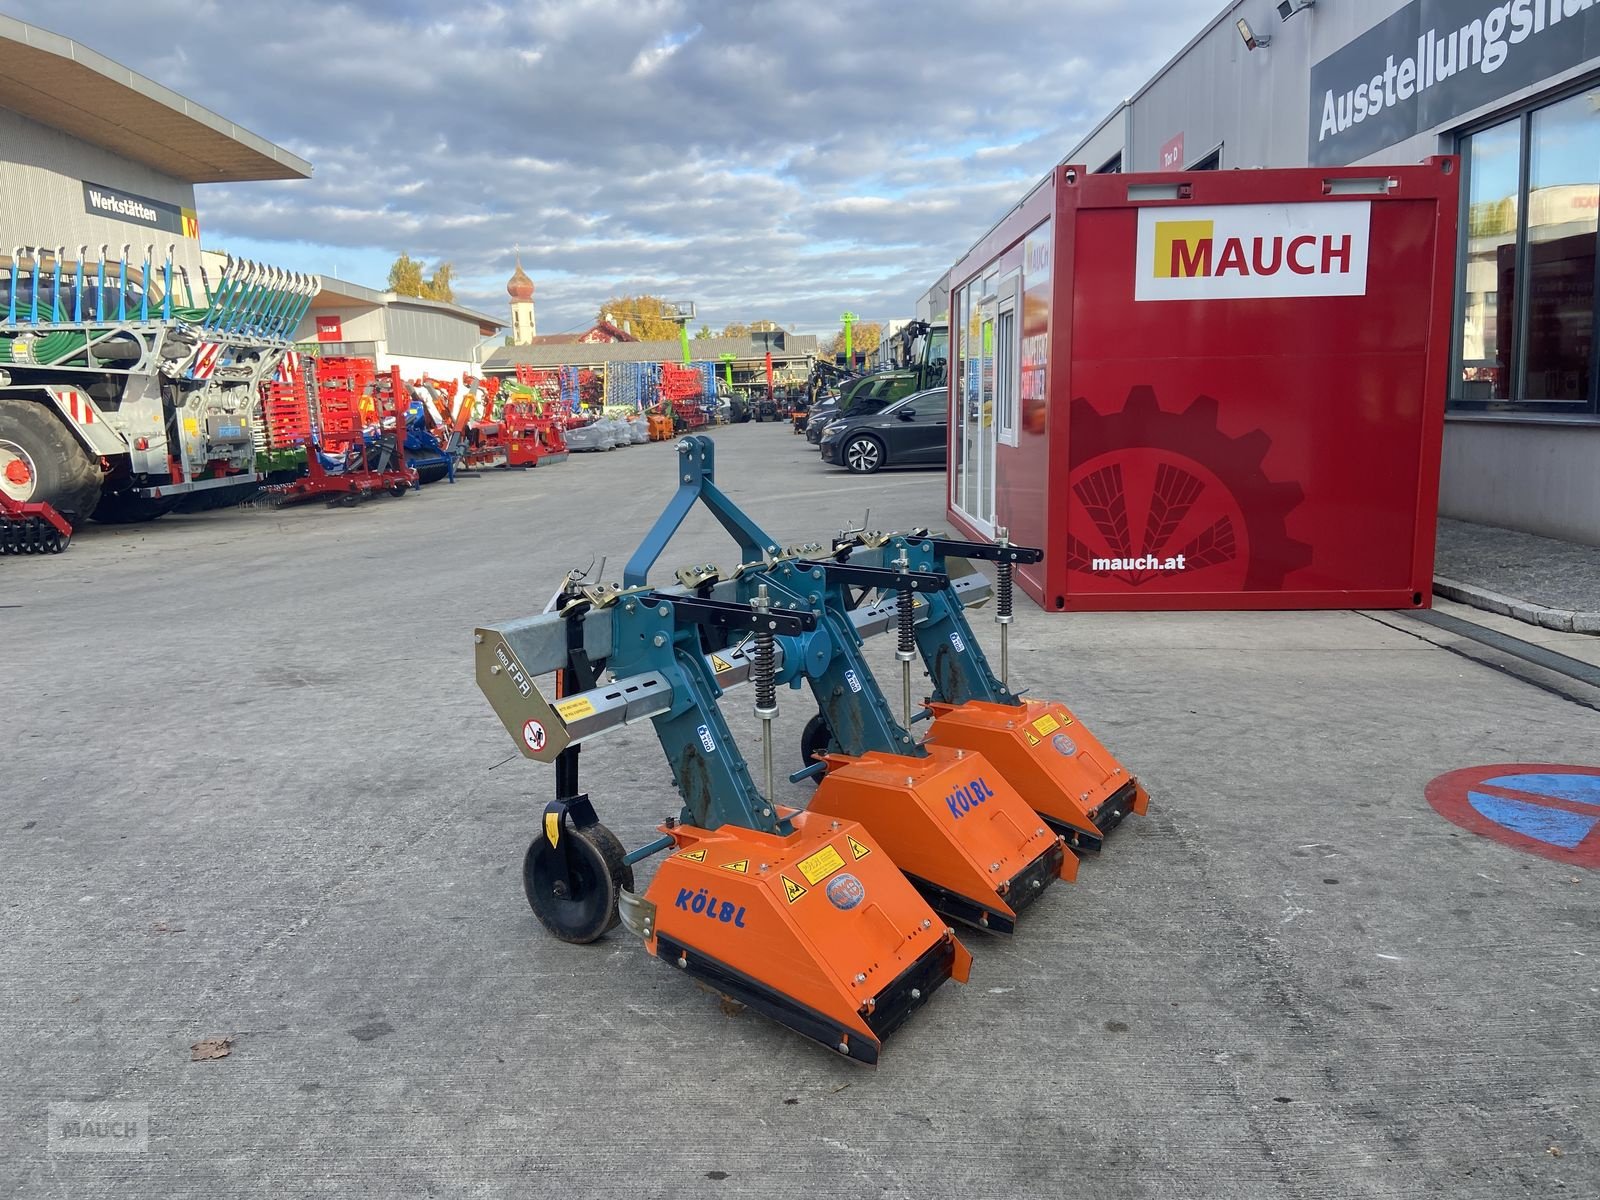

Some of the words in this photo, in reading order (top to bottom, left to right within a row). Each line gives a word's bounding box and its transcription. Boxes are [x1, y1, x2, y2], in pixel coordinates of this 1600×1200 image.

[89, 190, 157, 221] Werkstätten
[1170, 235, 1352, 278] MAUCH
[1092, 554, 1186, 570] mauch.at
[945, 777, 994, 820] KÖLBL
[675, 887, 746, 929] KÖLBL
